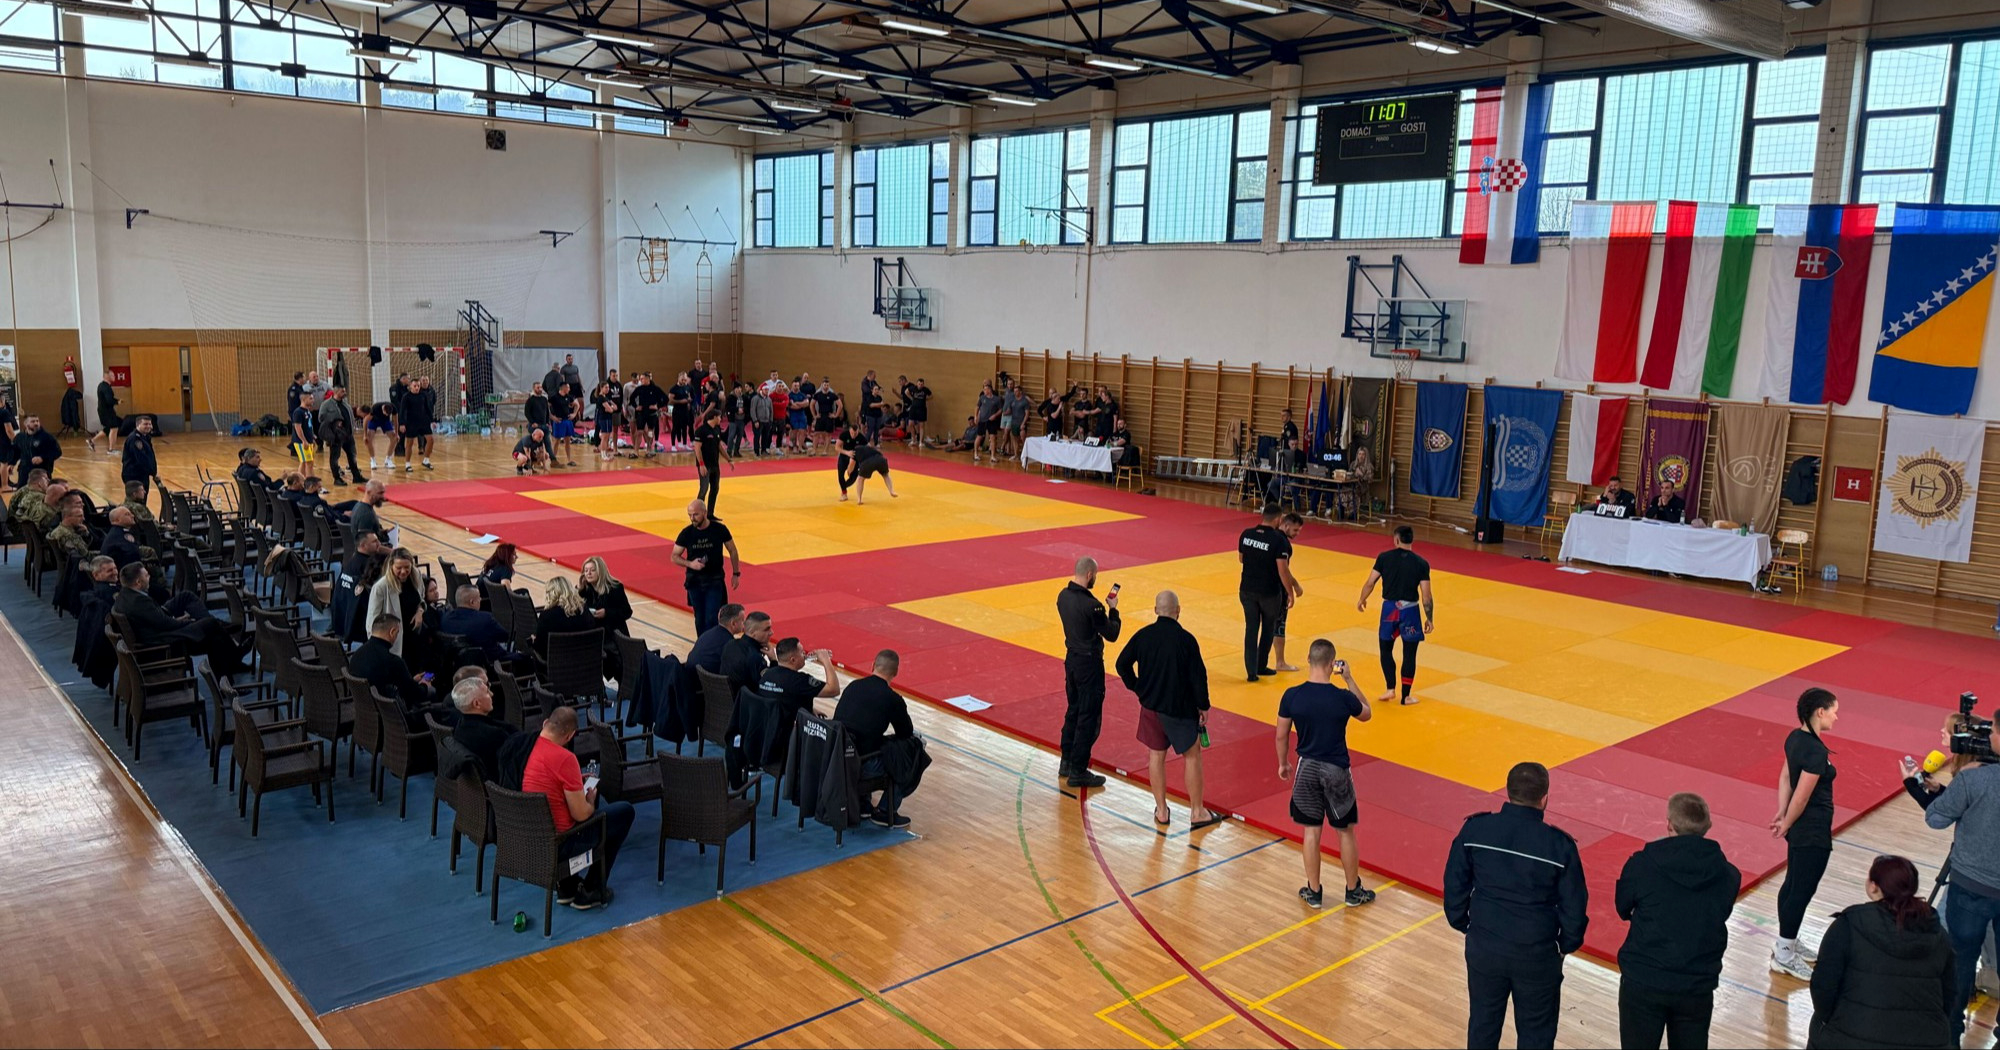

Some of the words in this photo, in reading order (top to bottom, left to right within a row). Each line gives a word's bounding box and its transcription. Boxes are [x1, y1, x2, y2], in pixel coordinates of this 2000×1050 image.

[1369, 102, 1406, 121] 11:07
[1340, 126, 1371, 138] DOMAĆI
[1400, 121, 1426, 133] GOSTI
[1323, 453, 1342, 461] 03:46
[1847, 478, 1861, 490] H
[1243, 537, 1270, 551] REFEREE
